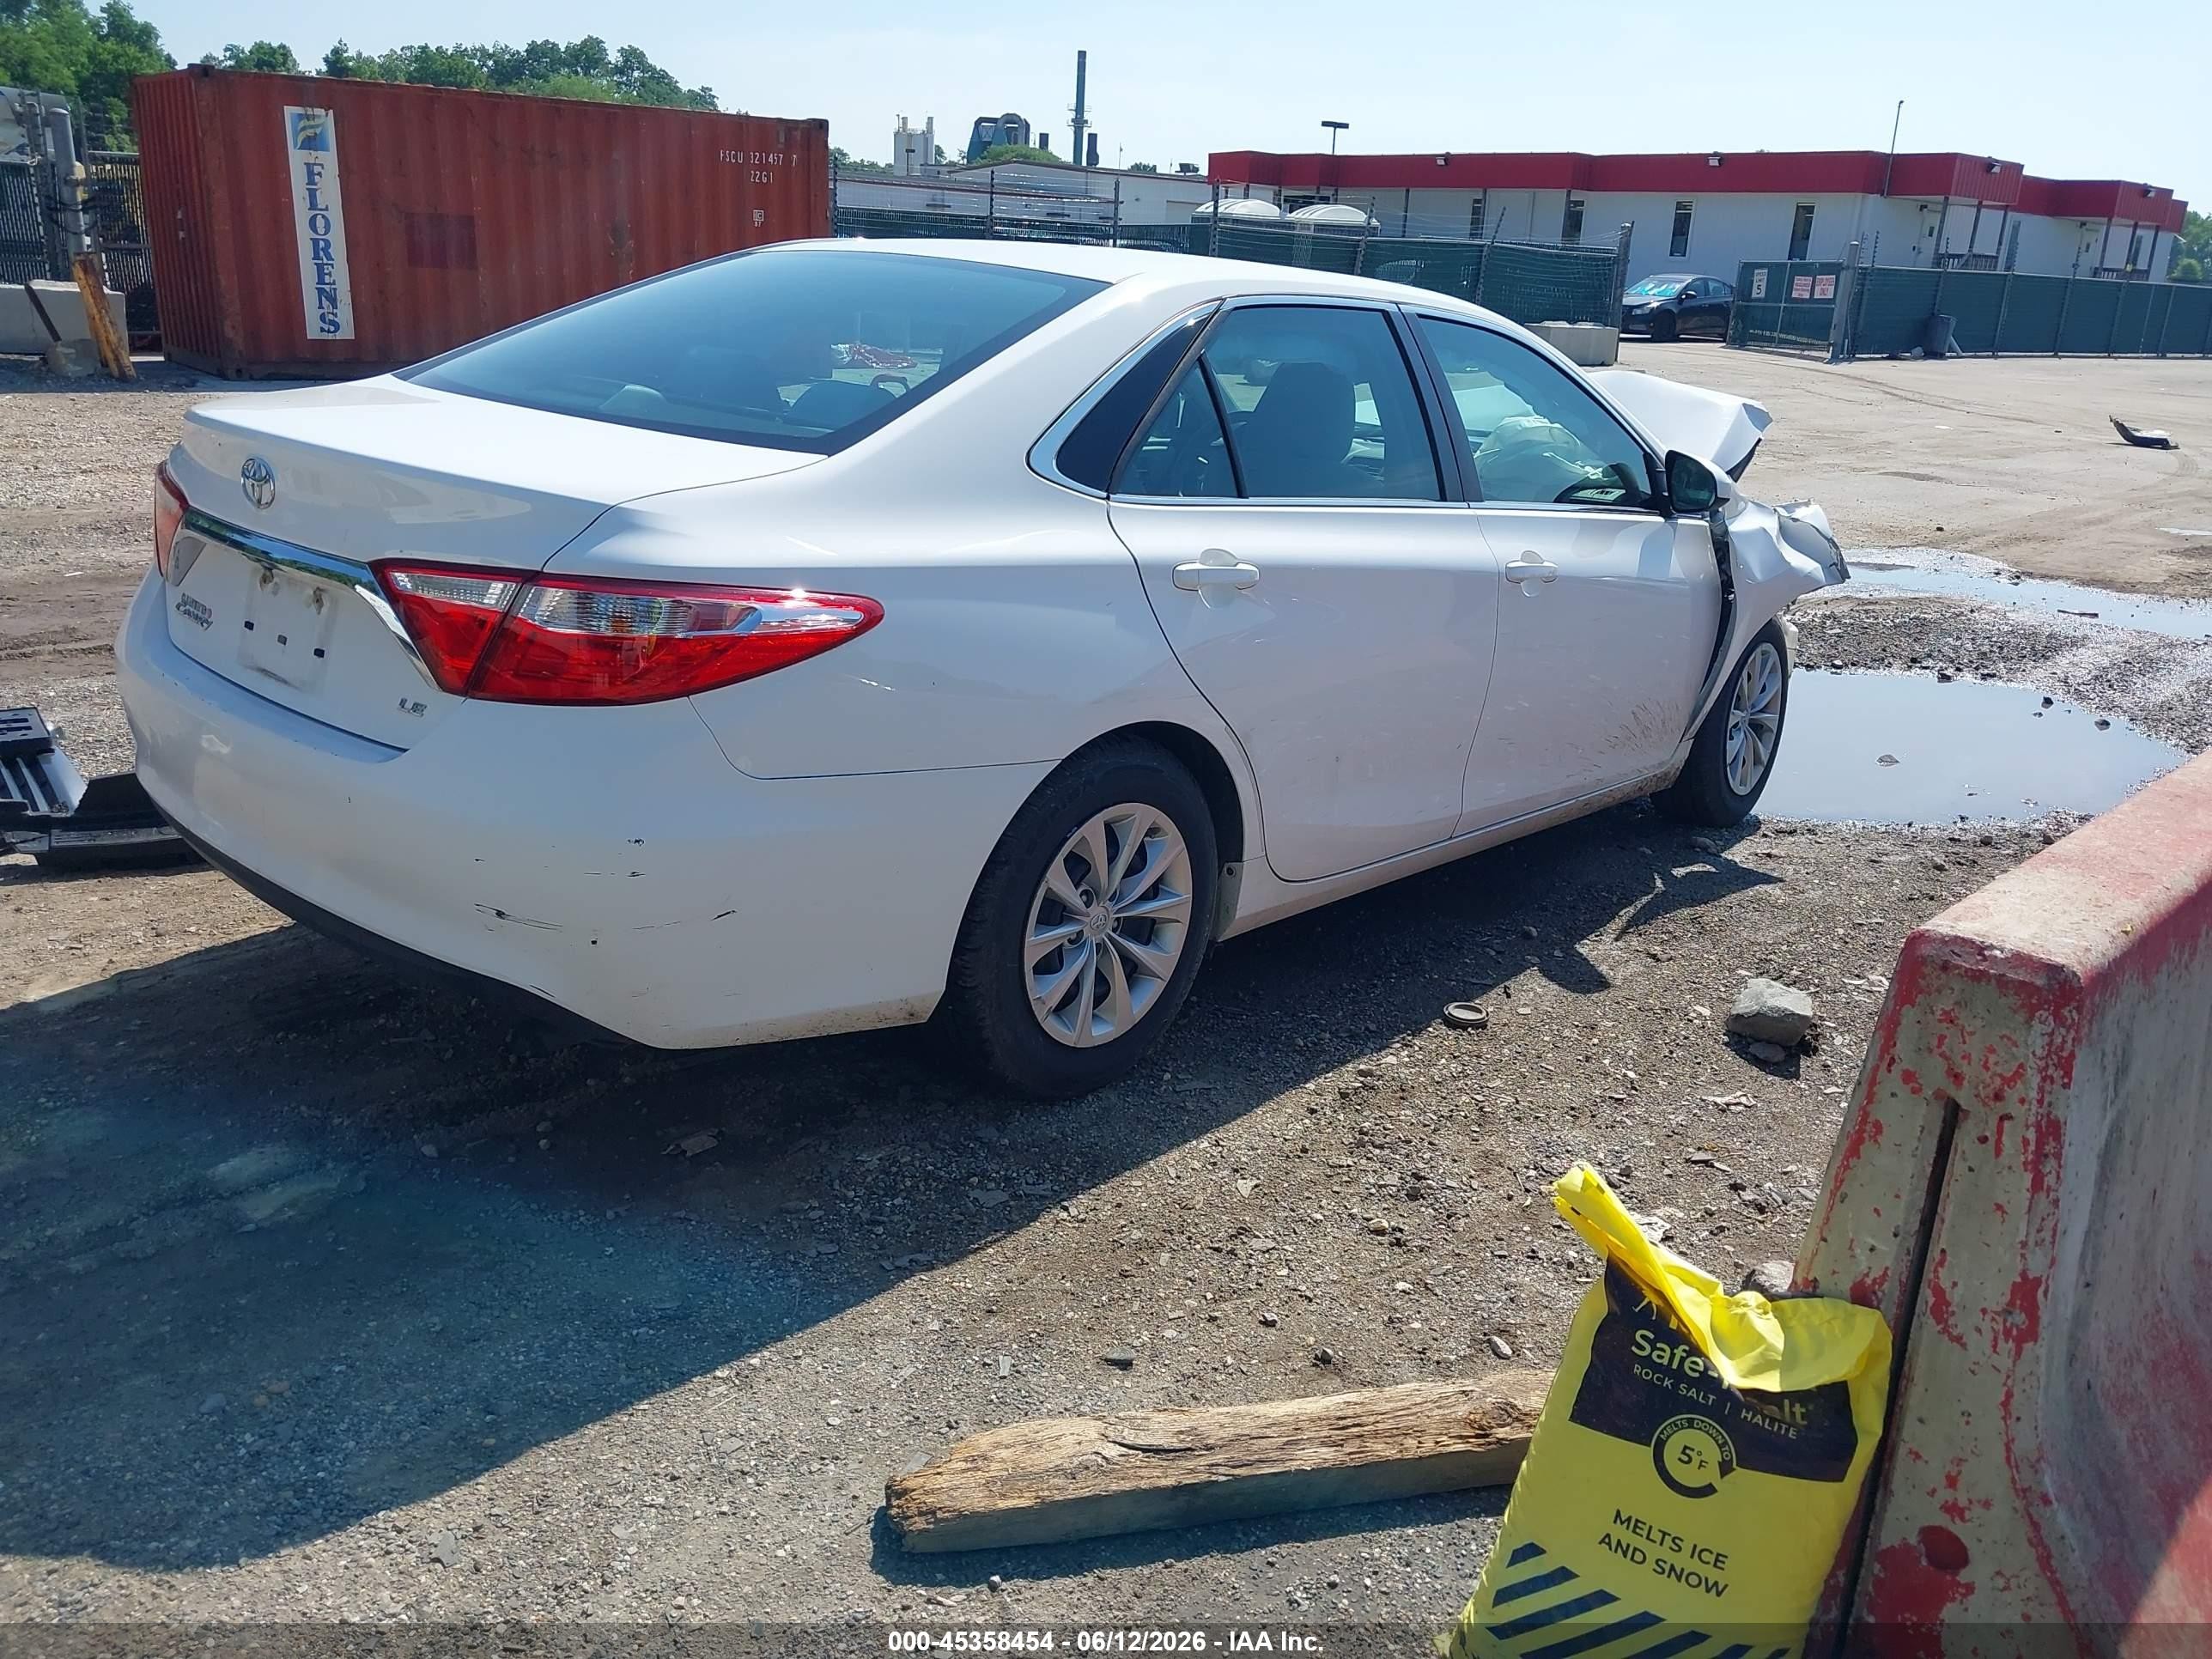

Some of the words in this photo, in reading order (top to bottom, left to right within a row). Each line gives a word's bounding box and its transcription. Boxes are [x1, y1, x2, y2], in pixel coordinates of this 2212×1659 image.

[750, 152, 784, 166] 321457
[750, 170, 774, 184] 22G1
[304, 161, 340, 334] FLORENS
[1756, 283, 1762, 295] 5
[1633, 1364, 1674, 1389] ROCK
[1678, 1383, 1717, 1407] SALT
[1741, 1408, 1798, 1439] HALITE
[1659, 1419, 1689, 1441] MELTS
[1693, 1419, 1725, 1444] DOWN
[1721, 1444, 1731, 1461] TO
[1598, 1532, 1647, 1565] AND
[1652, 1558, 1729, 1598] SNOW
[1613, 1509, 1685, 1553] MELTS
[1689, 1543, 1729, 1571] ICE
